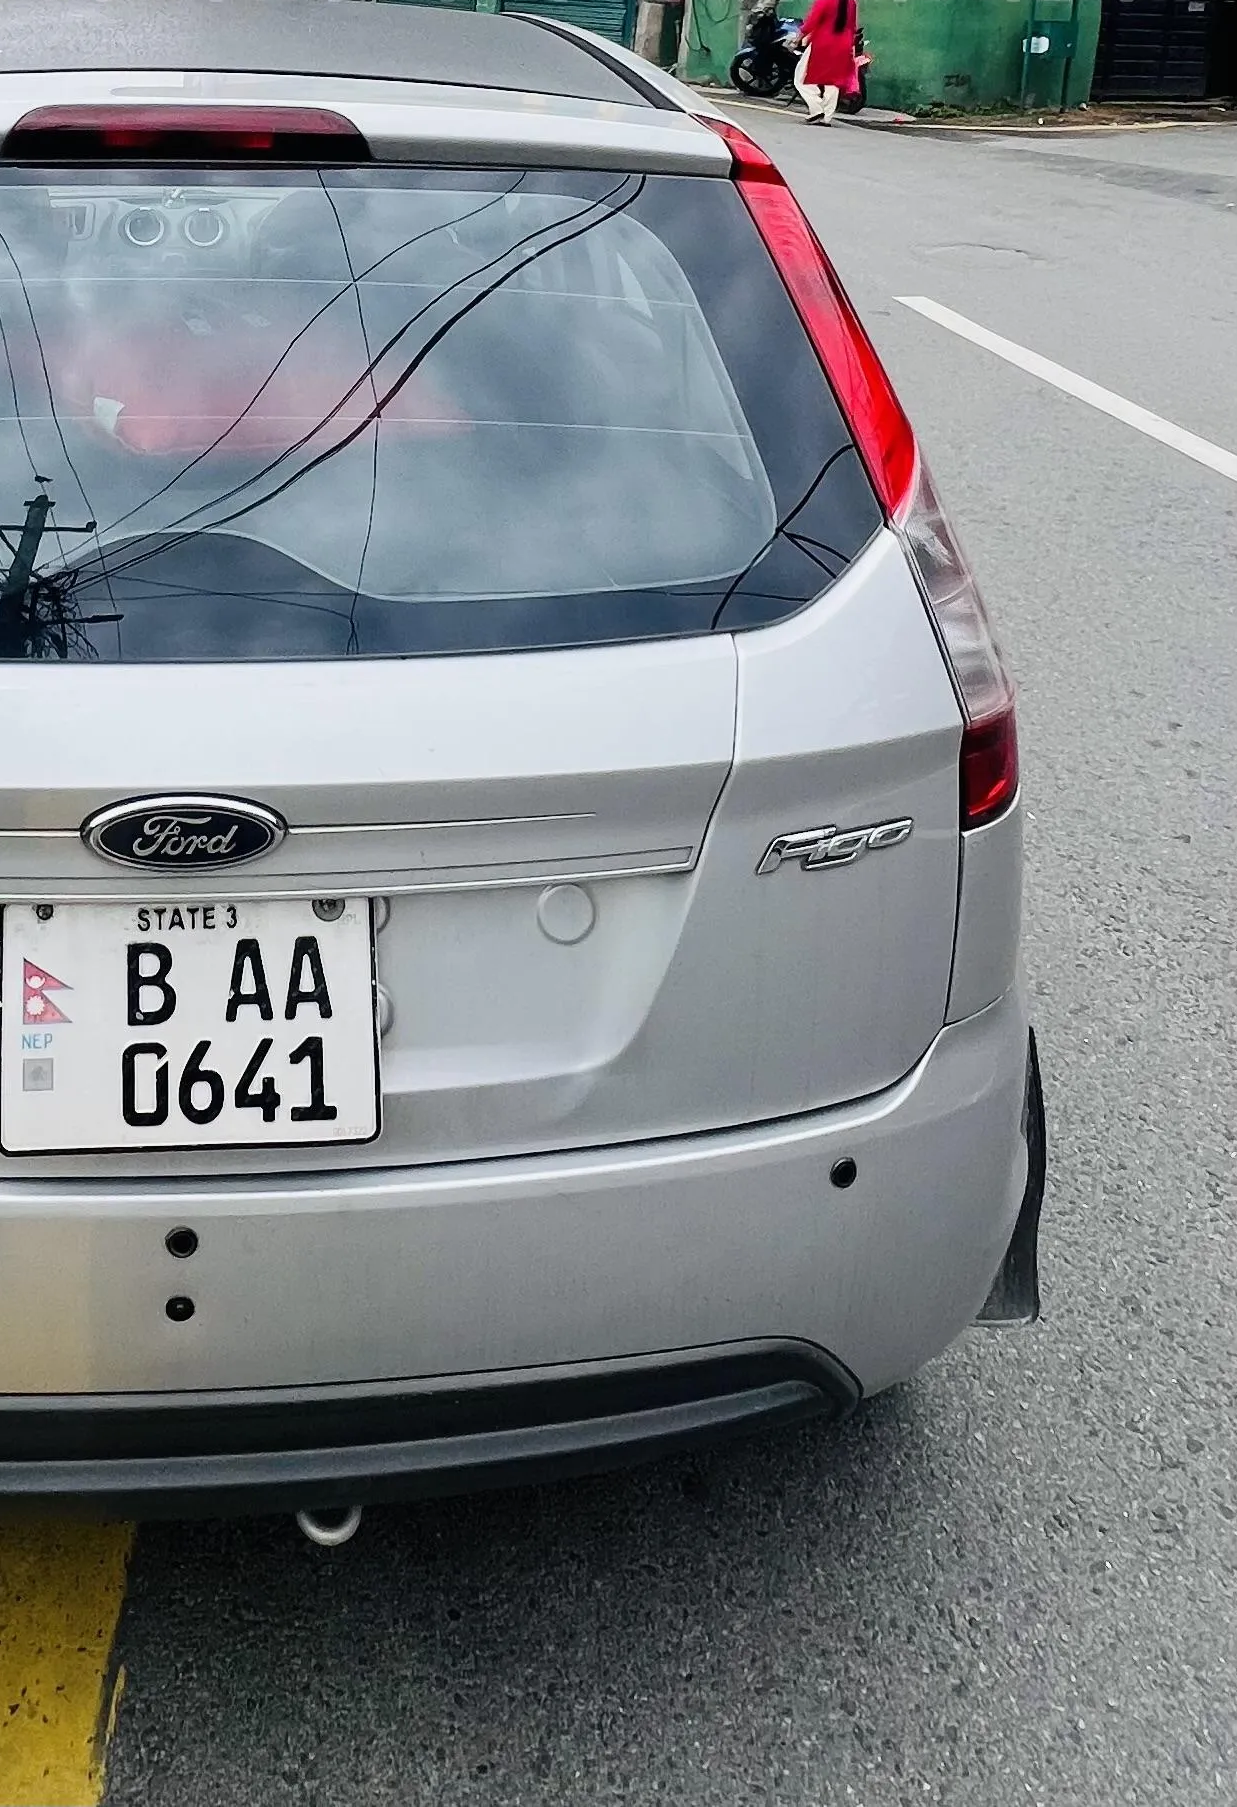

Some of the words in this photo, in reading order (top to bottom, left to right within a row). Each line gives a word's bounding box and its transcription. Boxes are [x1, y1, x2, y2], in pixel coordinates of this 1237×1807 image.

[133, 815, 239, 857] Ford
[755, 816, 913, 876] Figo
[137, 906, 216, 931] STATE
[226, 904, 238, 929] 3
[126, 942, 178, 1026] B
[225, 935, 334, 1023] AA
[21, 1033, 53, 1050] NEP
[121, 1035, 339, 1128] 0641
